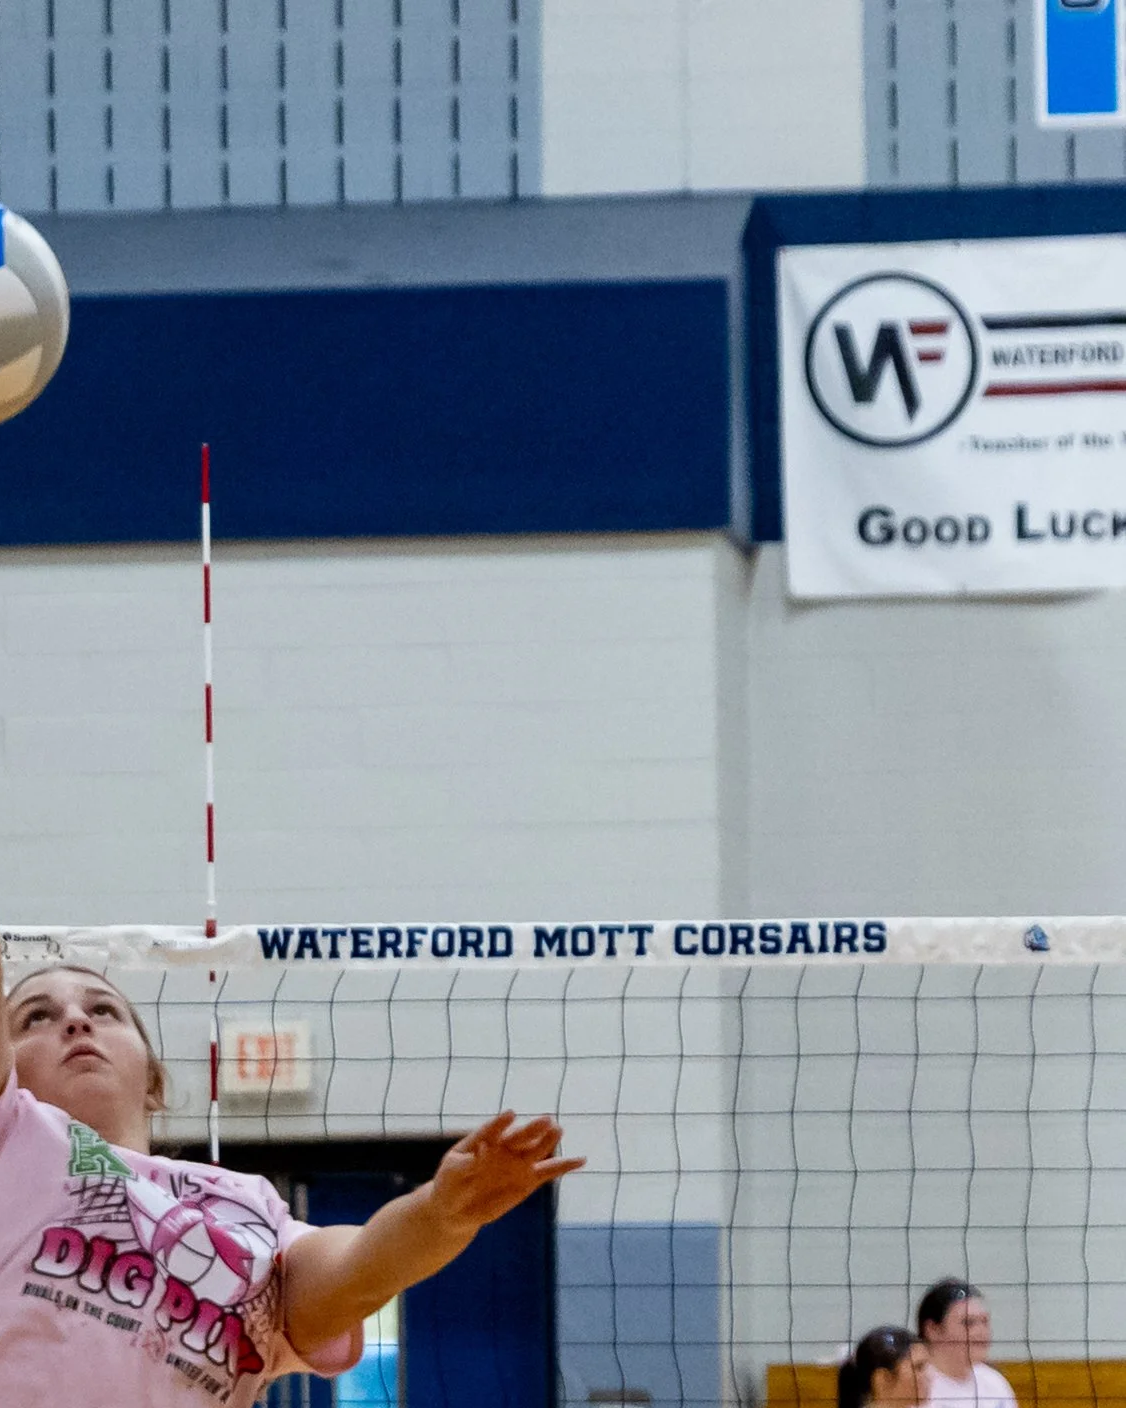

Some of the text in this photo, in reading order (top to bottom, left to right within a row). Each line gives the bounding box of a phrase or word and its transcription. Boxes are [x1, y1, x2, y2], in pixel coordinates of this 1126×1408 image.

[991, 340, 1125, 368] WATERFORD
[258, 921, 888, 961] WATERFORD MOTT CORSAIRS
[32, 1227, 157, 1309] DIG
[84, 1301, 103, 1320] THE
[106, 1311, 143, 1333] COURT
